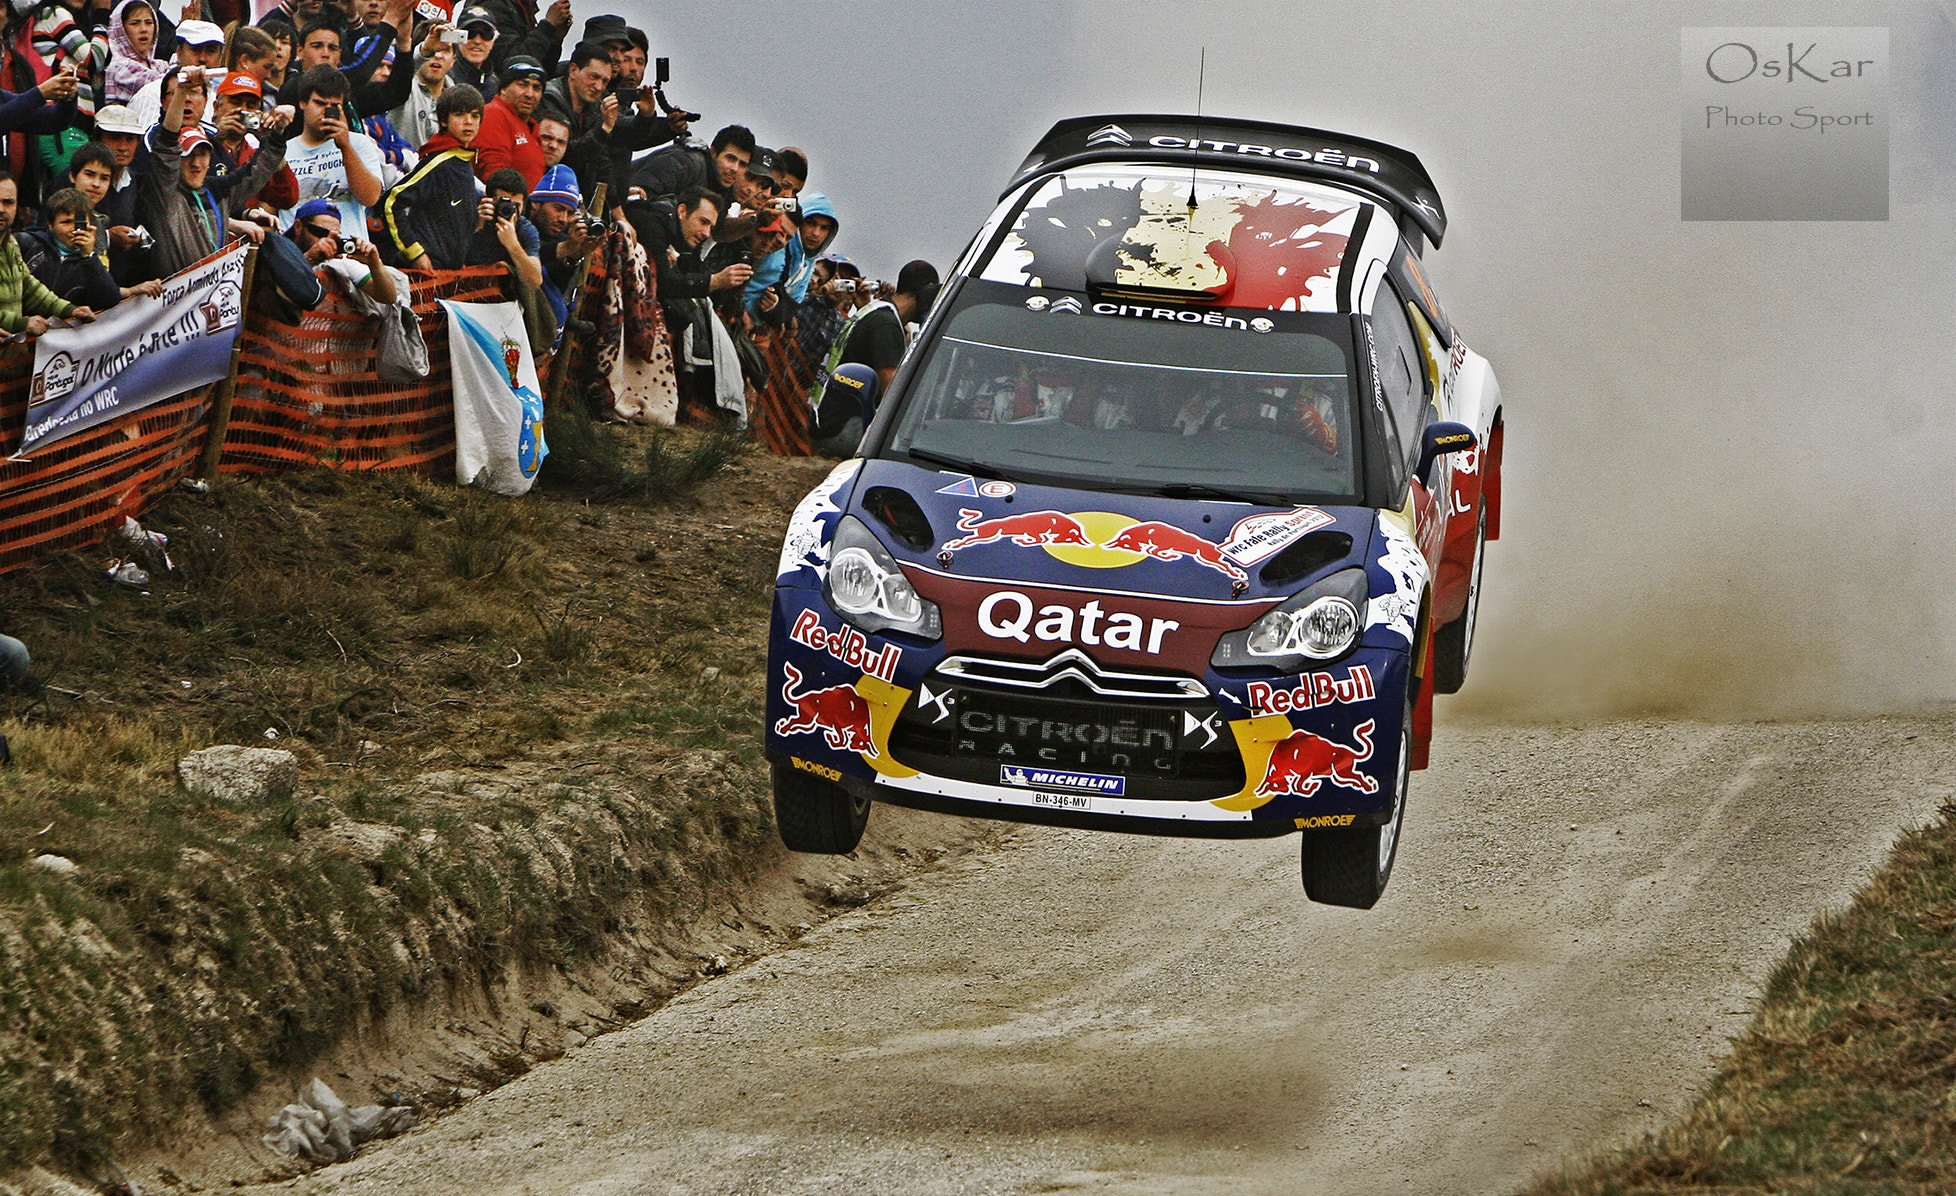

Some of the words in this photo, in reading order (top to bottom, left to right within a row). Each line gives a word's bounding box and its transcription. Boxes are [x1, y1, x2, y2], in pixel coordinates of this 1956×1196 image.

[94, 346, 135, 383] Norte
[94, 385, 120, 412] WRC
[1434, 433, 1470, 445] MONROE
[978, 591, 1181, 655] Qatar
[790, 608, 851, 661] Red
[843, 629, 902, 683] Bull
[1247, 672, 1313, 718] Red
[1311, 664, 1376, 708] Bull
[793, 756, 841, 782] MONROE
[1031, 772, 1119, 790] MICHELIN
[1035, 793, 1087, 808] BN-346-MV
[1295, 814, 1355, 829] MONROE
